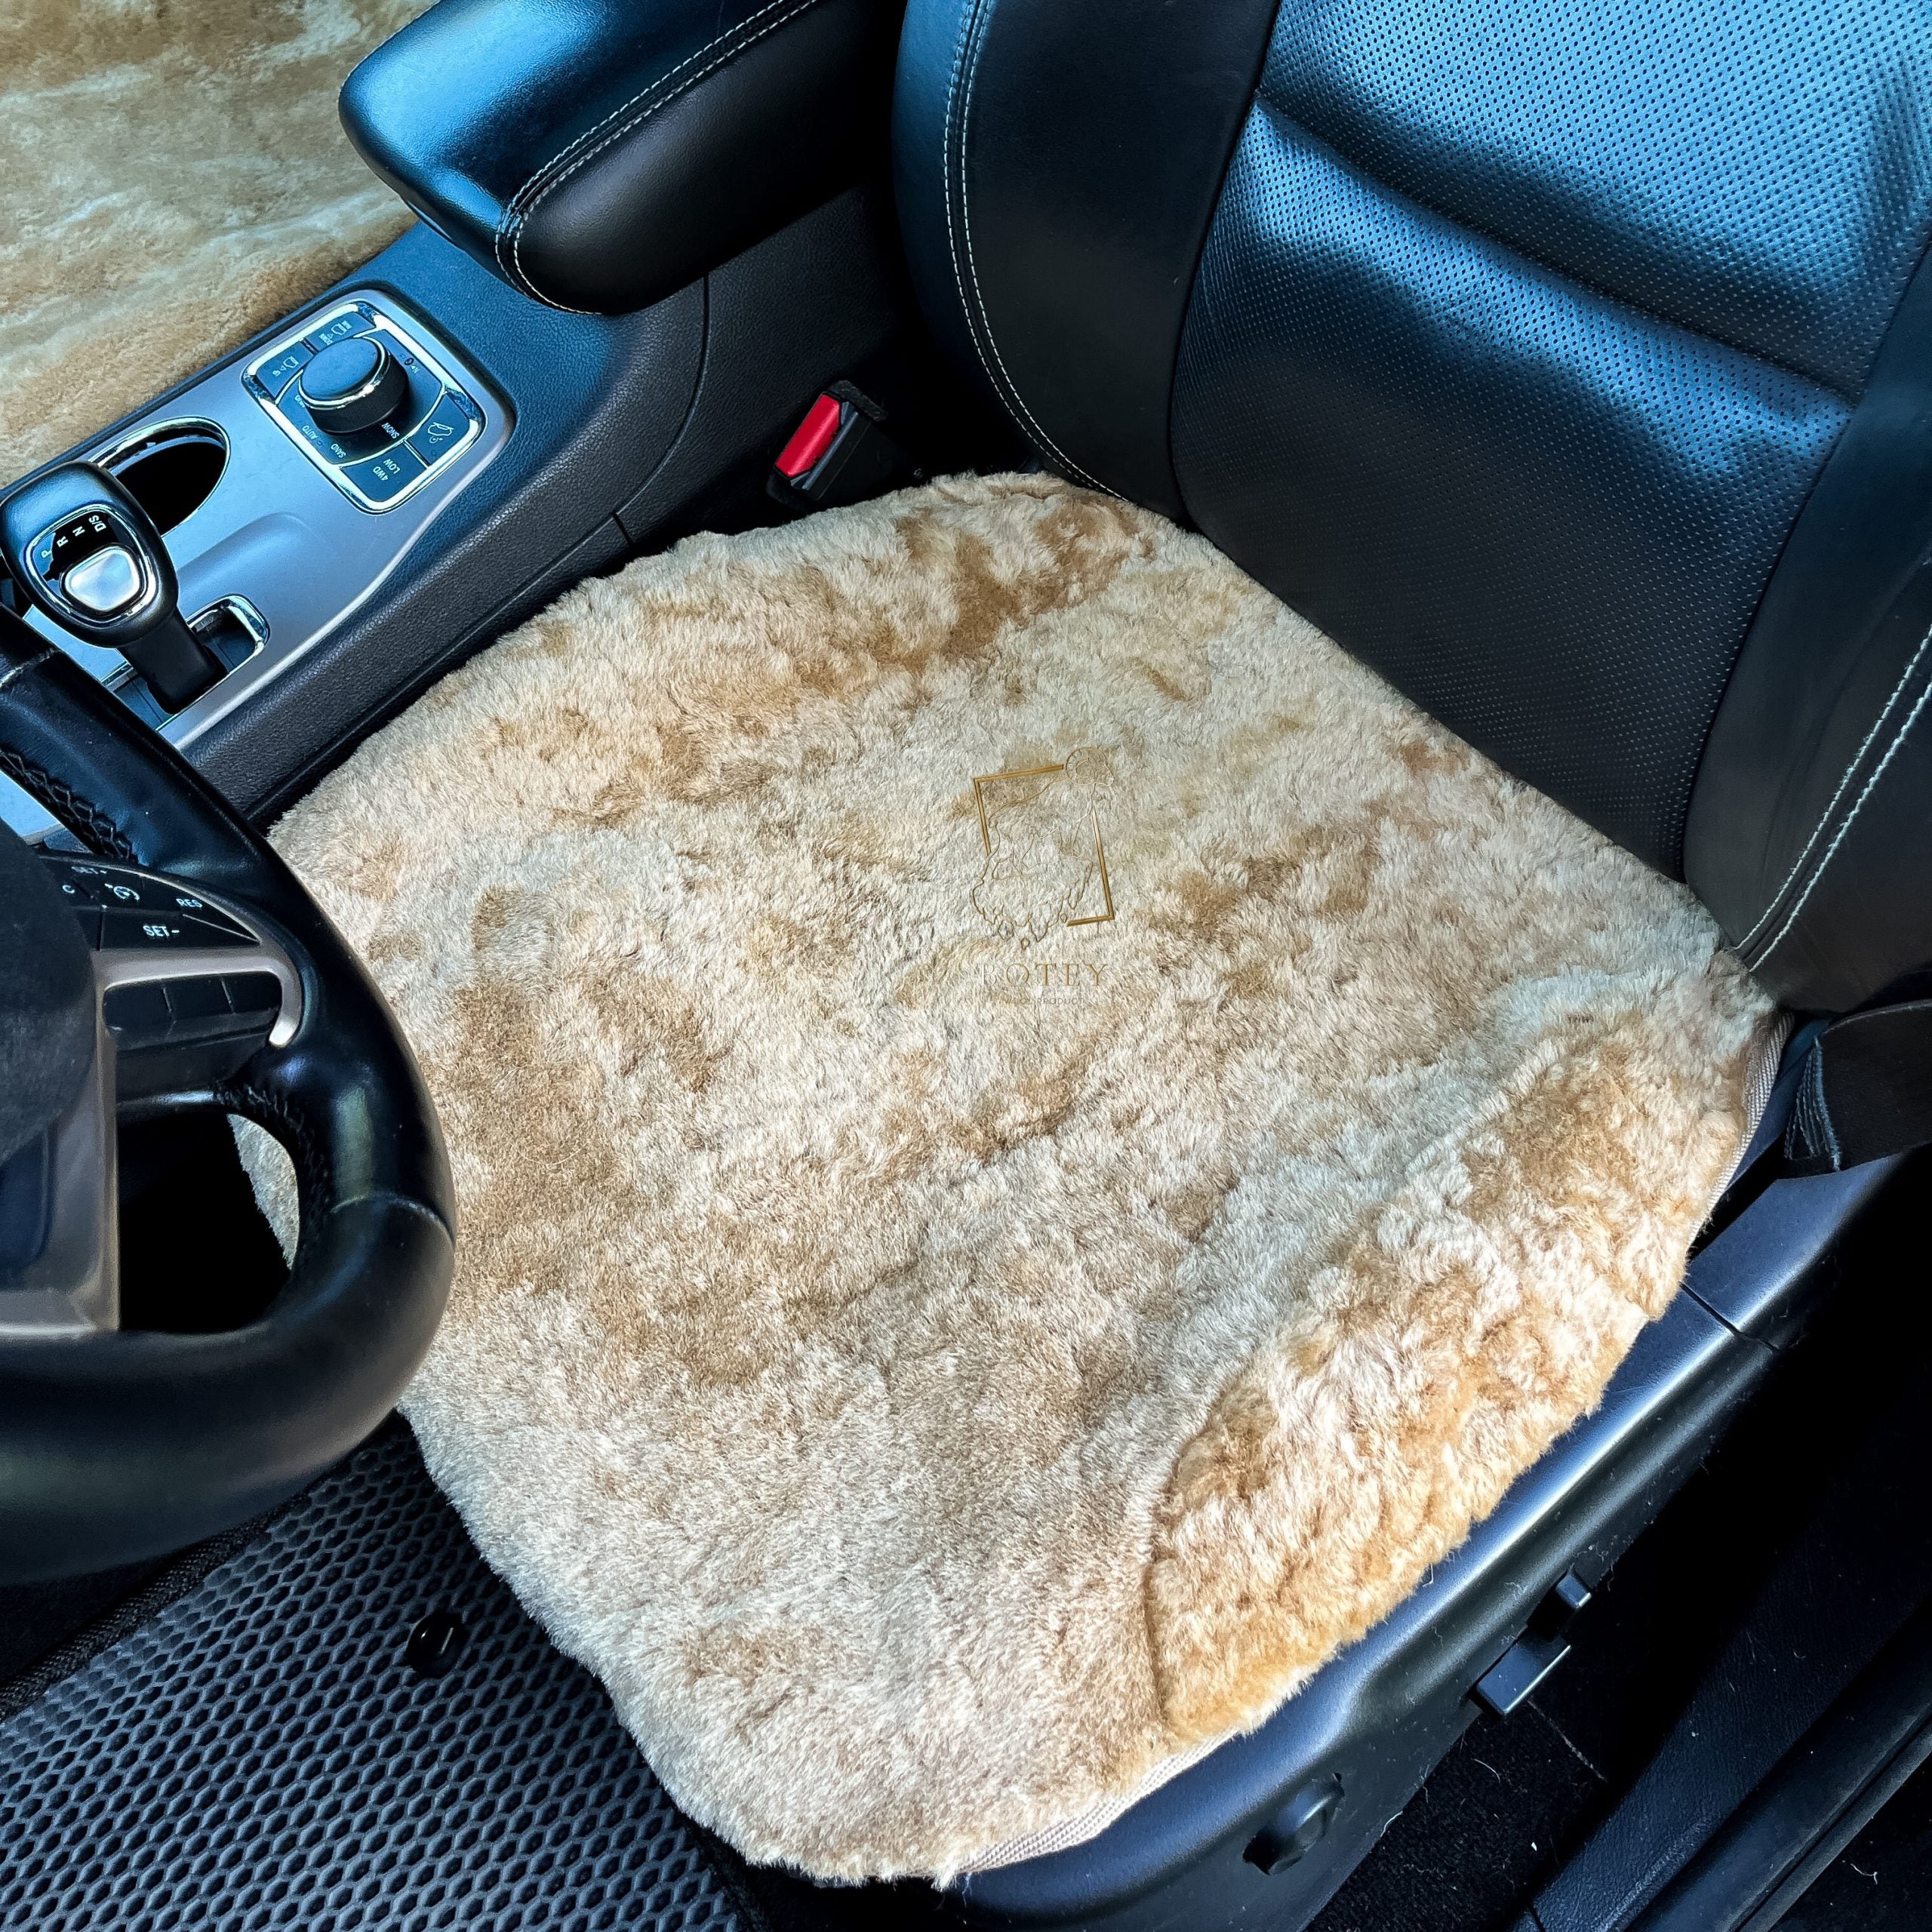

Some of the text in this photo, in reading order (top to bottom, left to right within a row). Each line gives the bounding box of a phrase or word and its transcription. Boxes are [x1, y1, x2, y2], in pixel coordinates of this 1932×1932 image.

[302, 425, 318, 440] AUTO
[381, 423, 400, 439] SNOW
[331, 443, 346, 458] SAND
[372, 466, 389, 481] 4WD
[383, 458, 401, 475] LOW
[72, 526, 85, 537] N
[56, 536, 69, 547] R
[41, 549, 52, 558] P
[175, 898, 203, 909] RES
